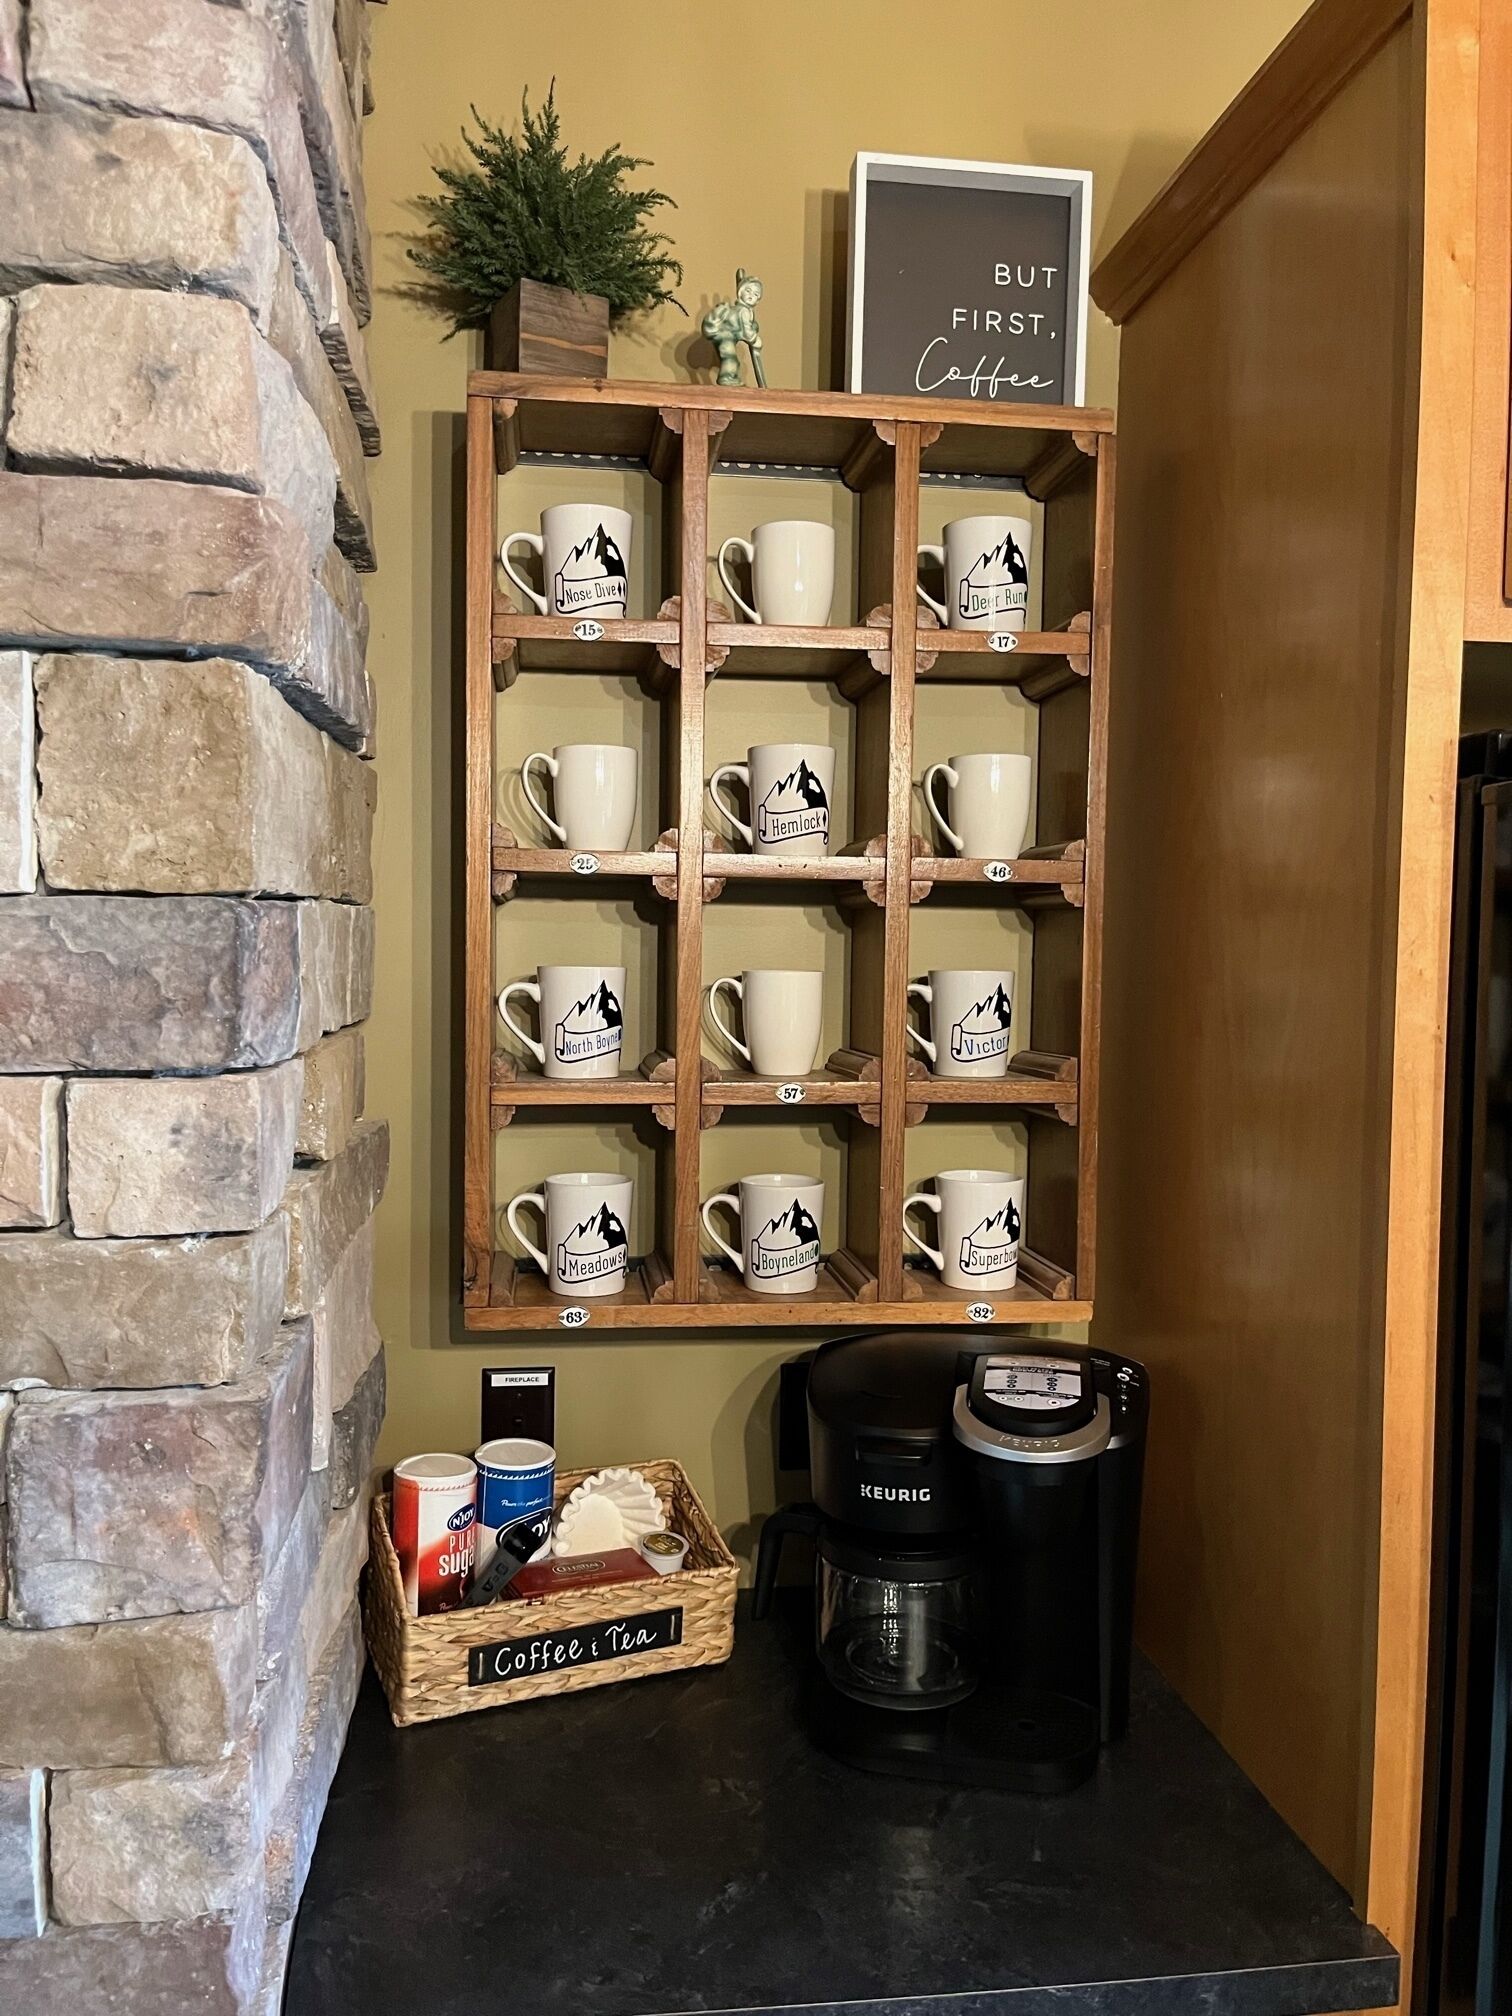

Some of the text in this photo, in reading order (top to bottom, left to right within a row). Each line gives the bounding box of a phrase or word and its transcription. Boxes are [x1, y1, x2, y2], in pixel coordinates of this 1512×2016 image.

[994, 263, 1058, 289] BUT
[952, 308, 1056, 340] FIRST,
[915, 336, 1054, 399] Coffee
[565, 582, 617, 604] Nose Dive
[1005, 588, 1023, 606] Run
[581, 624, 596, 636] 15
[997, 636, 1010, 648] 17
[771, 810, 821, 837] Hemlock
[577, 857, 593, 870] 25
[990, 865, 1007, 878] 46
[565, 1031, 618, 1056] North Boyne
[964, 1034, 1010, 1056] Victor
[783, 1087, 799, 1100] 57
[569, 1252, 623, 1277] Meadows
[761, 1242, 815, 1274] Boyneland
[971, 1248, 1017, 1271] Superbow
[565, 1311, 583, 1324] 63
[973, 1306, 989, 1319] 82
[860, 1483, 931, 1502] KEURIG
[494, 1638, 584, 1676] Coffee
[604, 1622, 657, 1652] Tea
